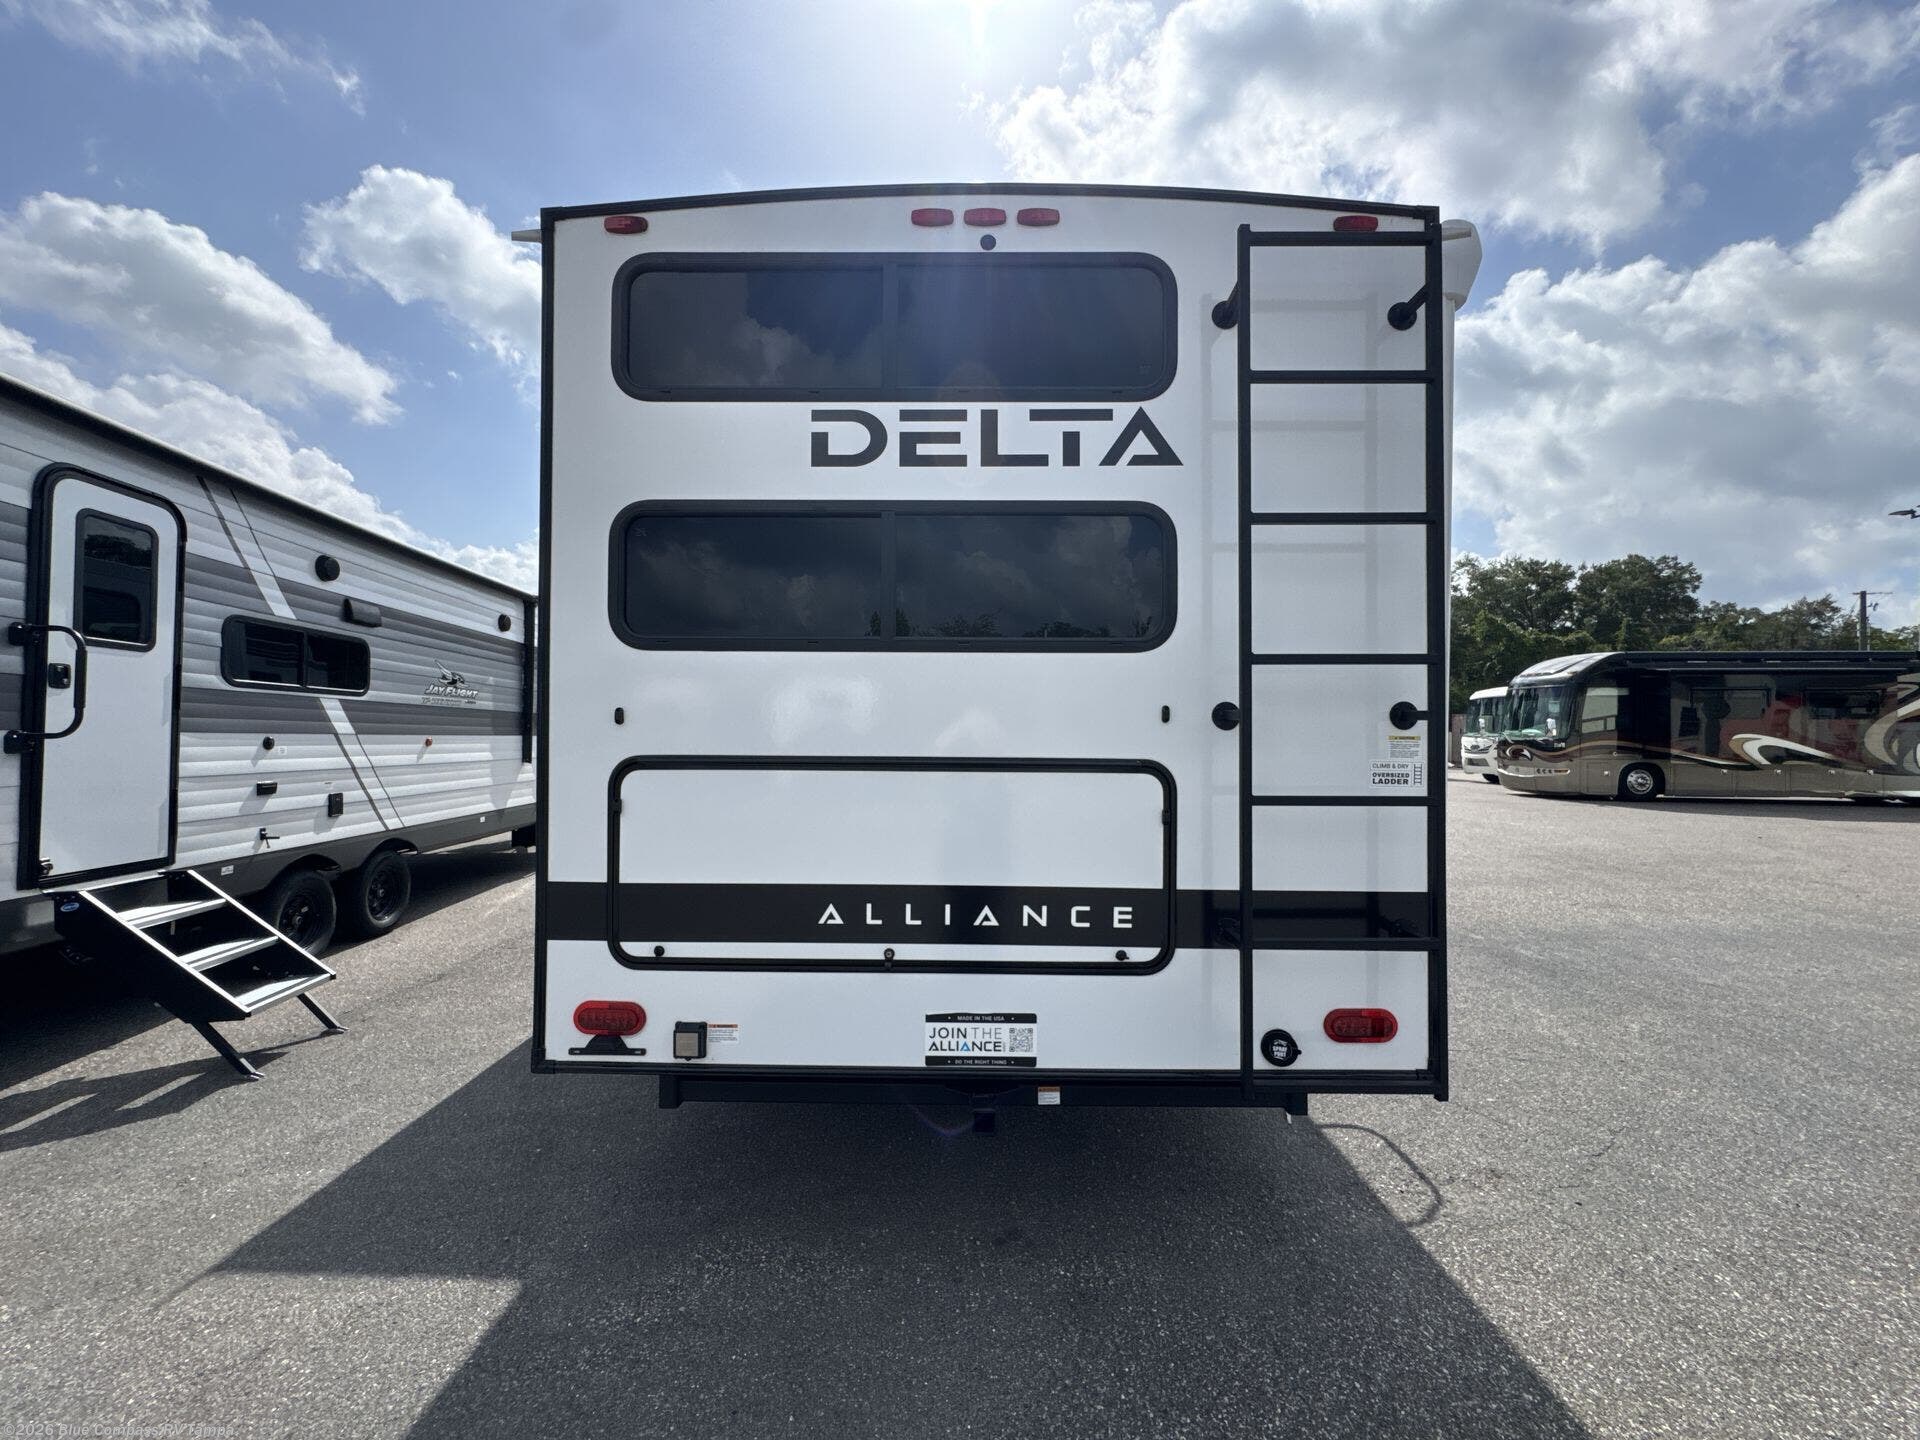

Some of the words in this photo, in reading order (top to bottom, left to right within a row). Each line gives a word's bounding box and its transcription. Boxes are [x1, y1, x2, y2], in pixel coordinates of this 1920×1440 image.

[811, 406, 1184, 467] DELTA
[425, 684, 445, 695] JAY
[445, 686, 479, 698] FLIGHT
[817, 903, 1133, 929] ALLIANCE
[928, 1027, 968, 1039] JOIN
[971, 1027, 1002, 1039] THE
[928, 1041, 1002, 1052] ALLIANCE
